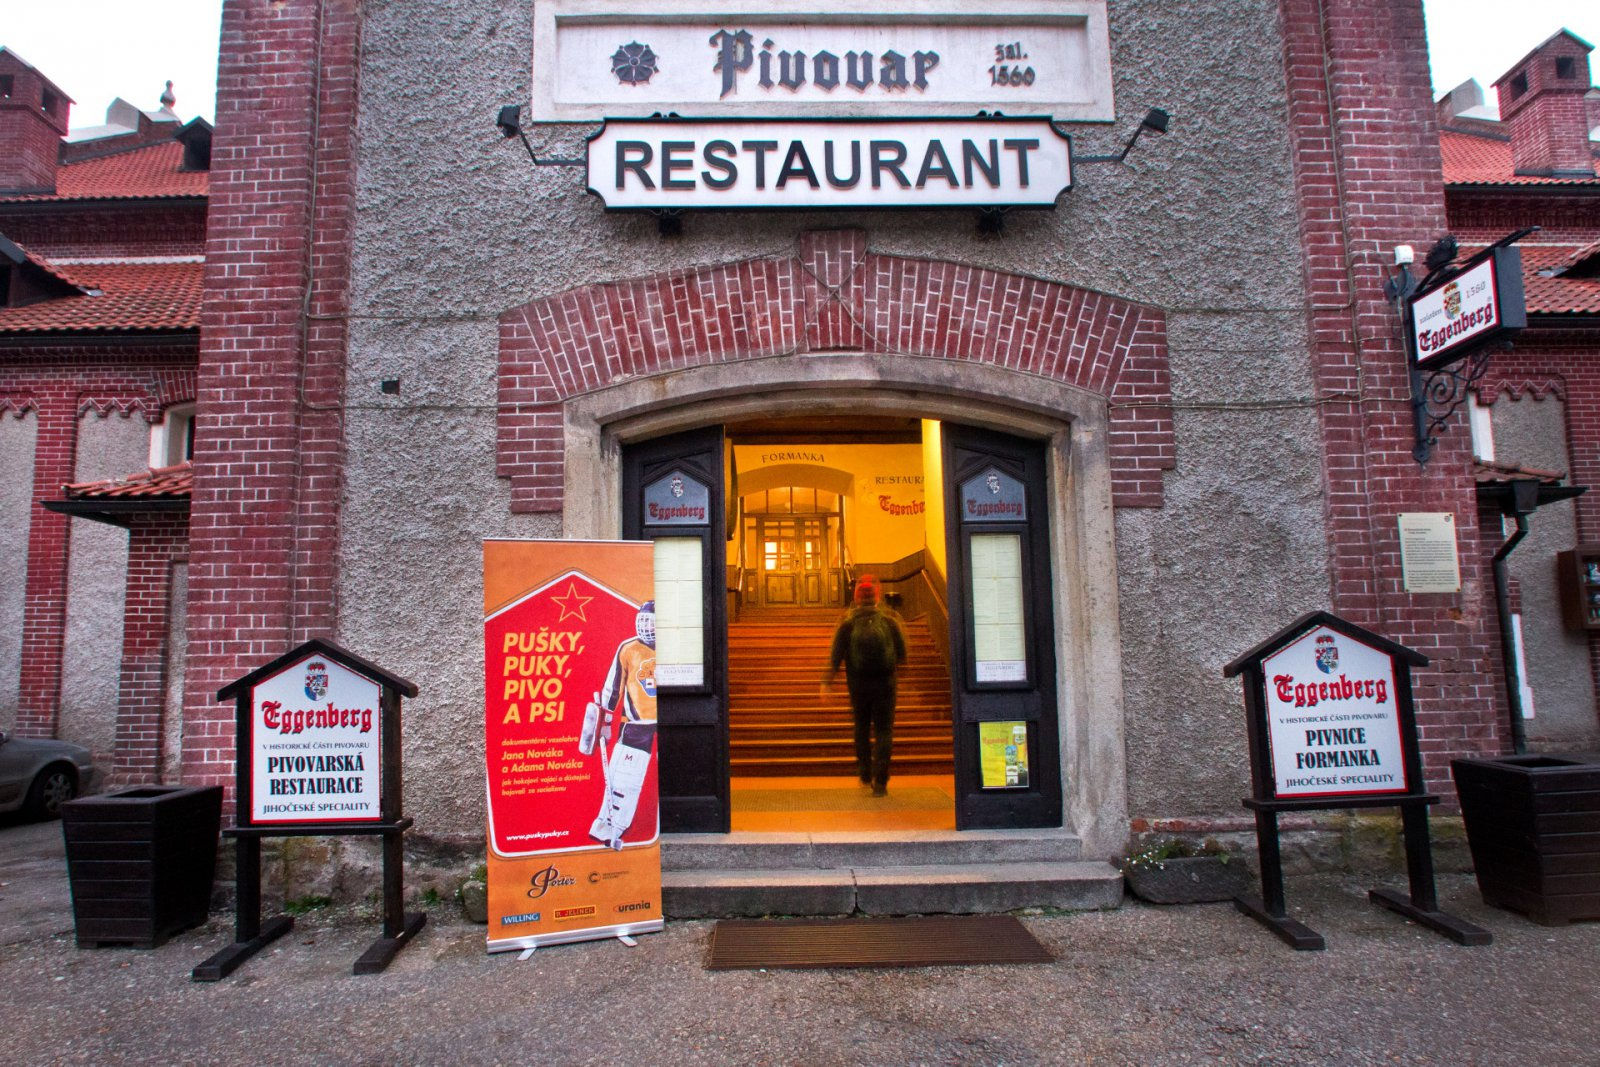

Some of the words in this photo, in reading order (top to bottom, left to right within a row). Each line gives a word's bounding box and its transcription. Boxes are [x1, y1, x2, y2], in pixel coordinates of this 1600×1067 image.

[708, 29, 940, 100] Pivovar
[988, 65, 1036, 87] 1560
[614, 139, 1040, 190] RESTAURANT
[1419, 303, 1493, 351] Eggenberg
[761, 452, 825, 463] FORMANKA
[648, 502, 704, 520] Eggenberg
[503, 626, 585, 655] PUŠKY,
[503, 655, 572, 678] PUKY,
[503, 677, 563, 700] PIVO
[1273, 673, 1388, 708] Eggenberg
[261, 700, 372, 735] Eggenberg
[502, 703, 521, 724] A
[529, 701, 565, 723] PSI
[269, 742, 311, 750] HISTORICKÉ
[312, 741, 333, 749] ČÁSTI
[1305, 727, 1366, 746] PIVNICE
[268, 752, 364, 773] PIVOVARSKÁ
[502, 751, 524, 760] Jana
[526, 748, 563, 759] Nováka
[1296, 749, 1380, 769] FORMANKA
[511, 762, 544, 773] Adama
[547, 759, 583, 770] Nováka
[270, 777, 363, 795] RESTAURACE
[1286, 775, 1337, 787] JIHOČESKÉ
[1341, 774, 1394, 784] SPECIALITY
[263, 802, 315, 814] JIHOČESKÉ
[318, 802, 370, 811] SPECIALITY
[506, 830, 569, 841] www.puskypuky.cz
[527, 863, 576, 898] Porter
[618, 900, 651, 912] urania
[504, 914, 538, 924] WILLING
